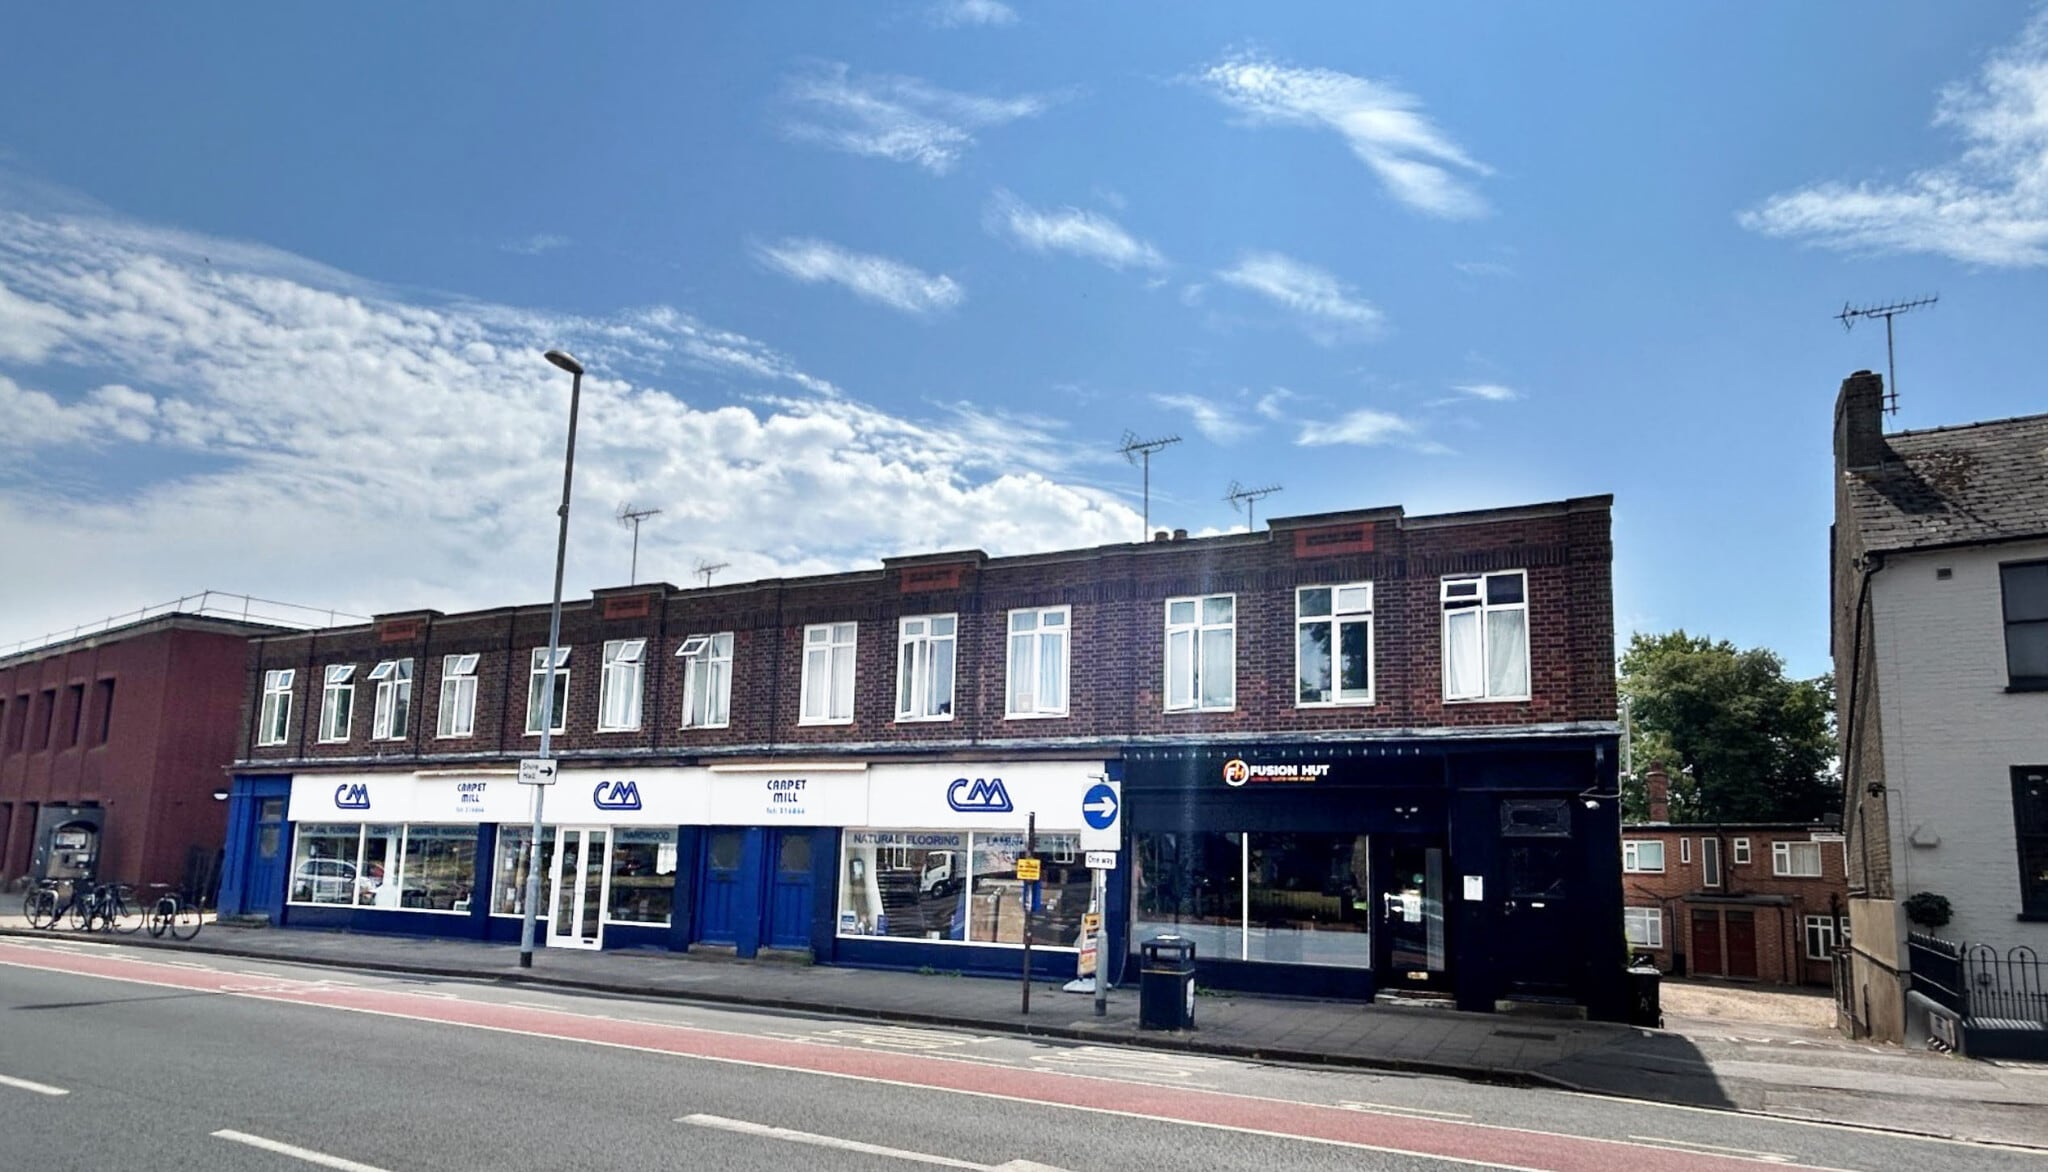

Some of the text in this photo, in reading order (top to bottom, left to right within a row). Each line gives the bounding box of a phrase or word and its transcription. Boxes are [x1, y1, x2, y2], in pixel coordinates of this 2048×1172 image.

[1250, 764, 1330, 777] FUSION HUT
[457, 782, 487, 792] CARPET
[767, 779, 807, 791] CARPET
[461, 793, 480, 803] MILL
[773, 792, 798, 803] MILL
[853, 834, 960, 846] NATURAL FLOORING
